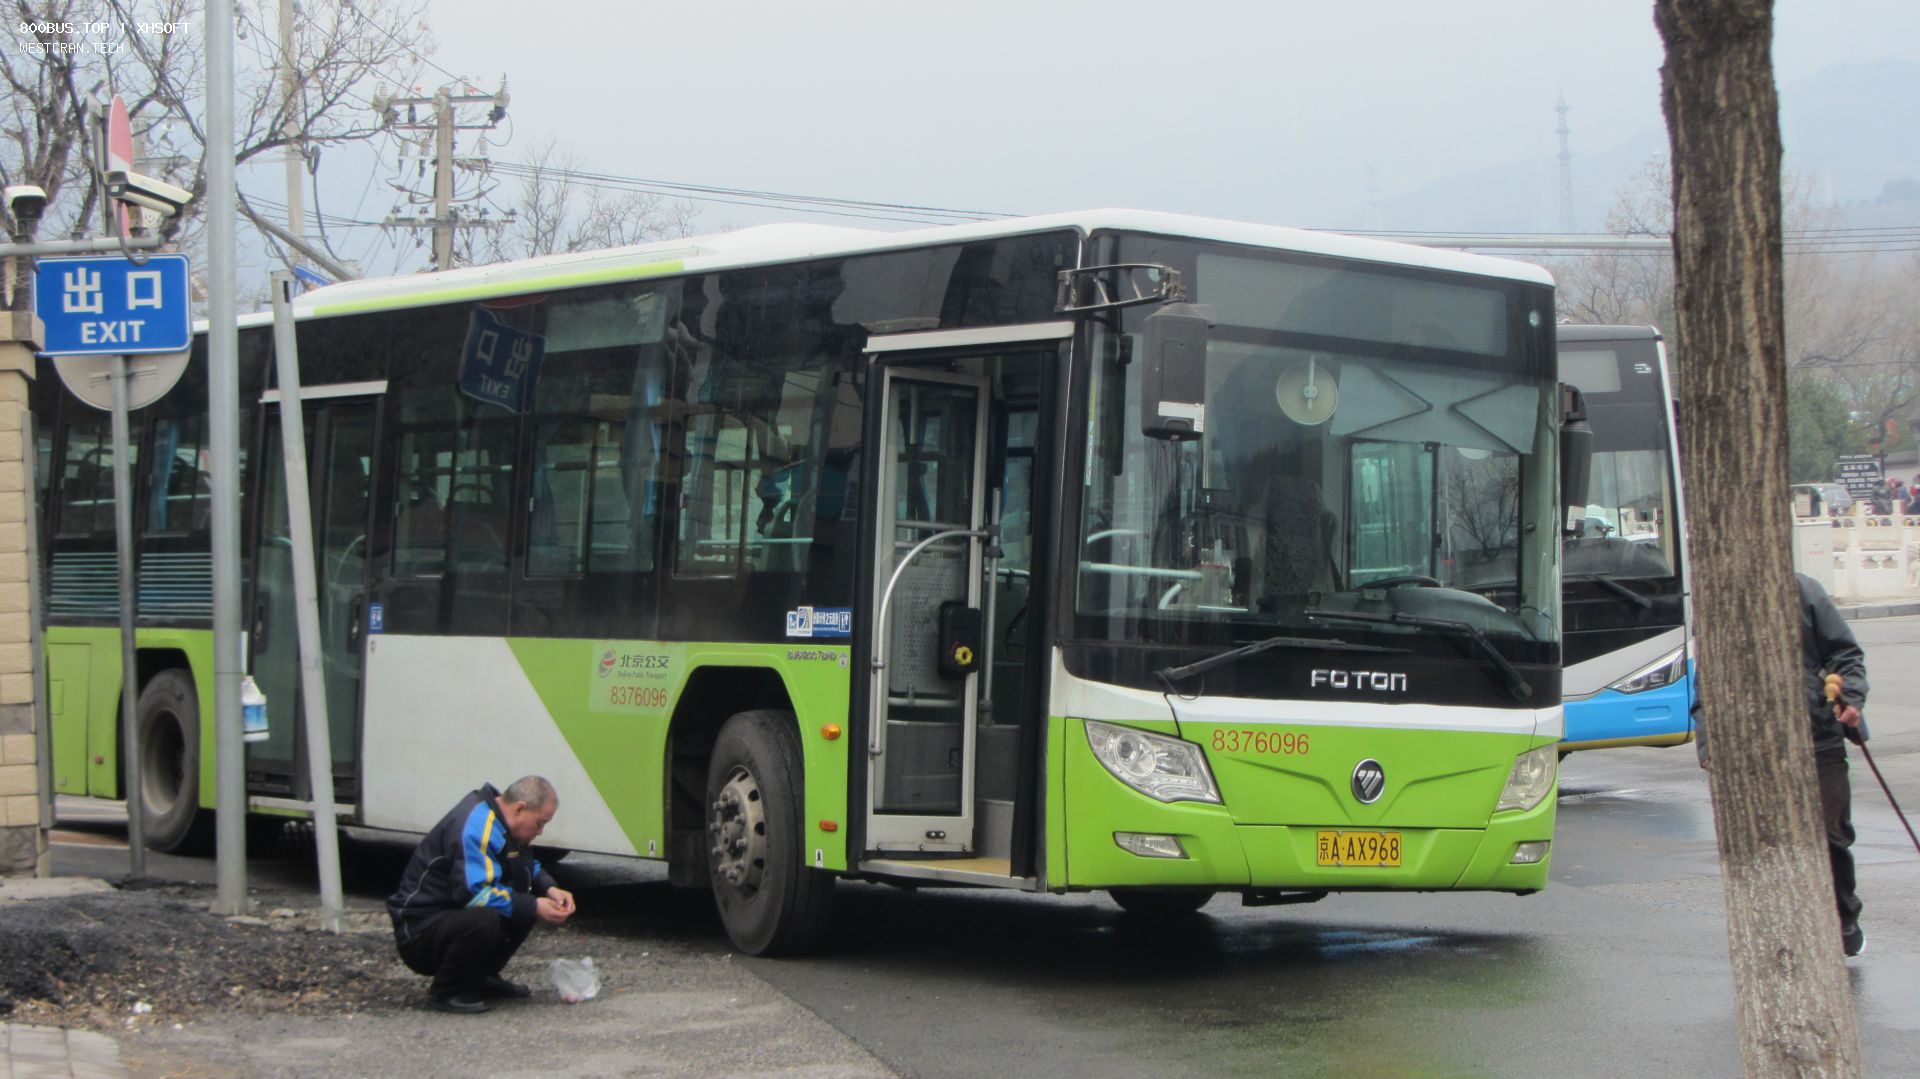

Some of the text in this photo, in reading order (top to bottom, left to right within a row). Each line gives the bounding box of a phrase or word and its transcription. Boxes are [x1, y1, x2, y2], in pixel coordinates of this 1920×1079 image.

[63, 267, 163, 314] 出口
[81, 320, 146, 344] EXIT
[620, 654, 670, 669] 北京公交
[1311, 669, 1407, 692] FOTON
[610, 685, 668, 708] 8376096
[1212, 729, 1310, 755] 8376096
